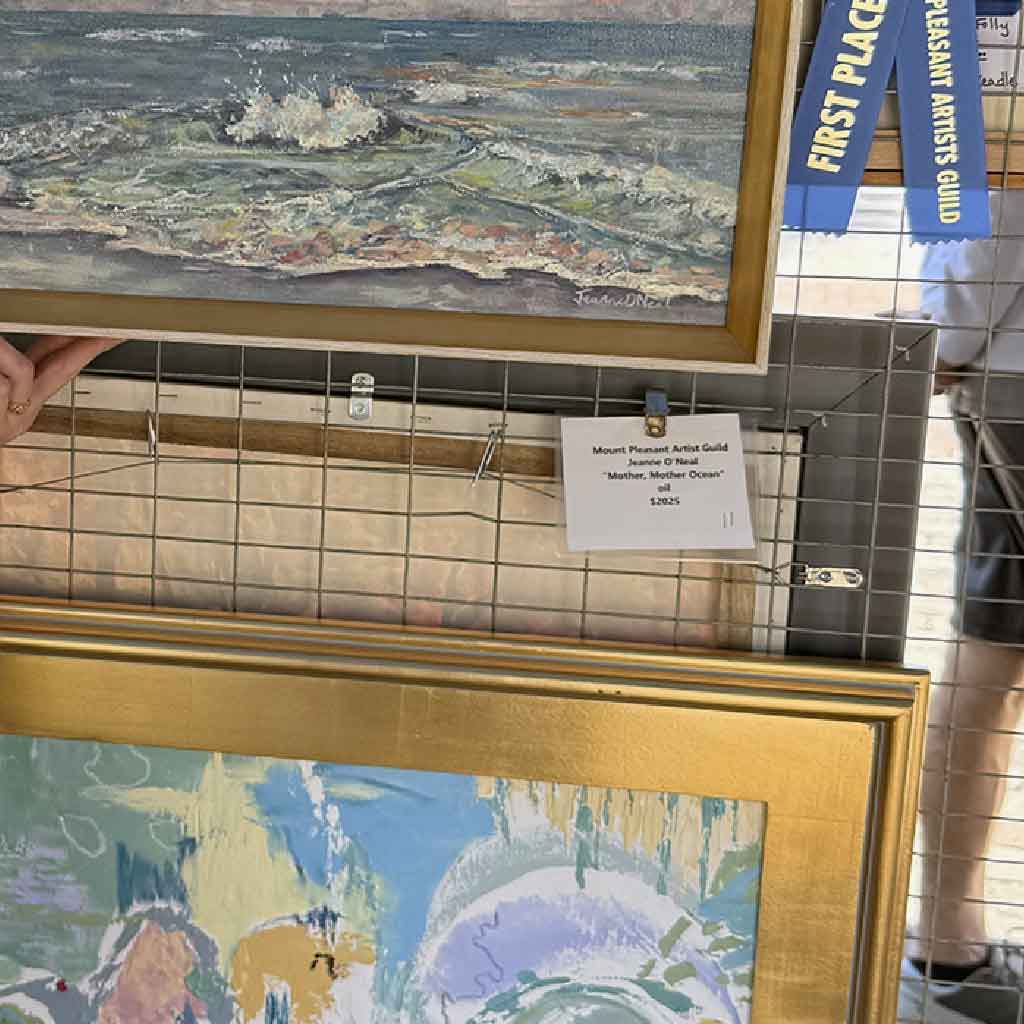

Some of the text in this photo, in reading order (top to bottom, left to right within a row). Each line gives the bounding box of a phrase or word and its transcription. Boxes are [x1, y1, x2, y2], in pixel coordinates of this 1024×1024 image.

[806, 89, 861, 173] FIRST
[930, 92, 960, 166] ARTISTS
[935, 170, 962, 224] GUILD
[592, 446, 626, 455] Mount
[628, 445, 669, 453] Pleasant
[701, 443, 729, 452] Guild
[627, 458, 662, 466] Jeanne
[649, 471, 686, 479] Mother
[657, 483, 671, 492] oil
